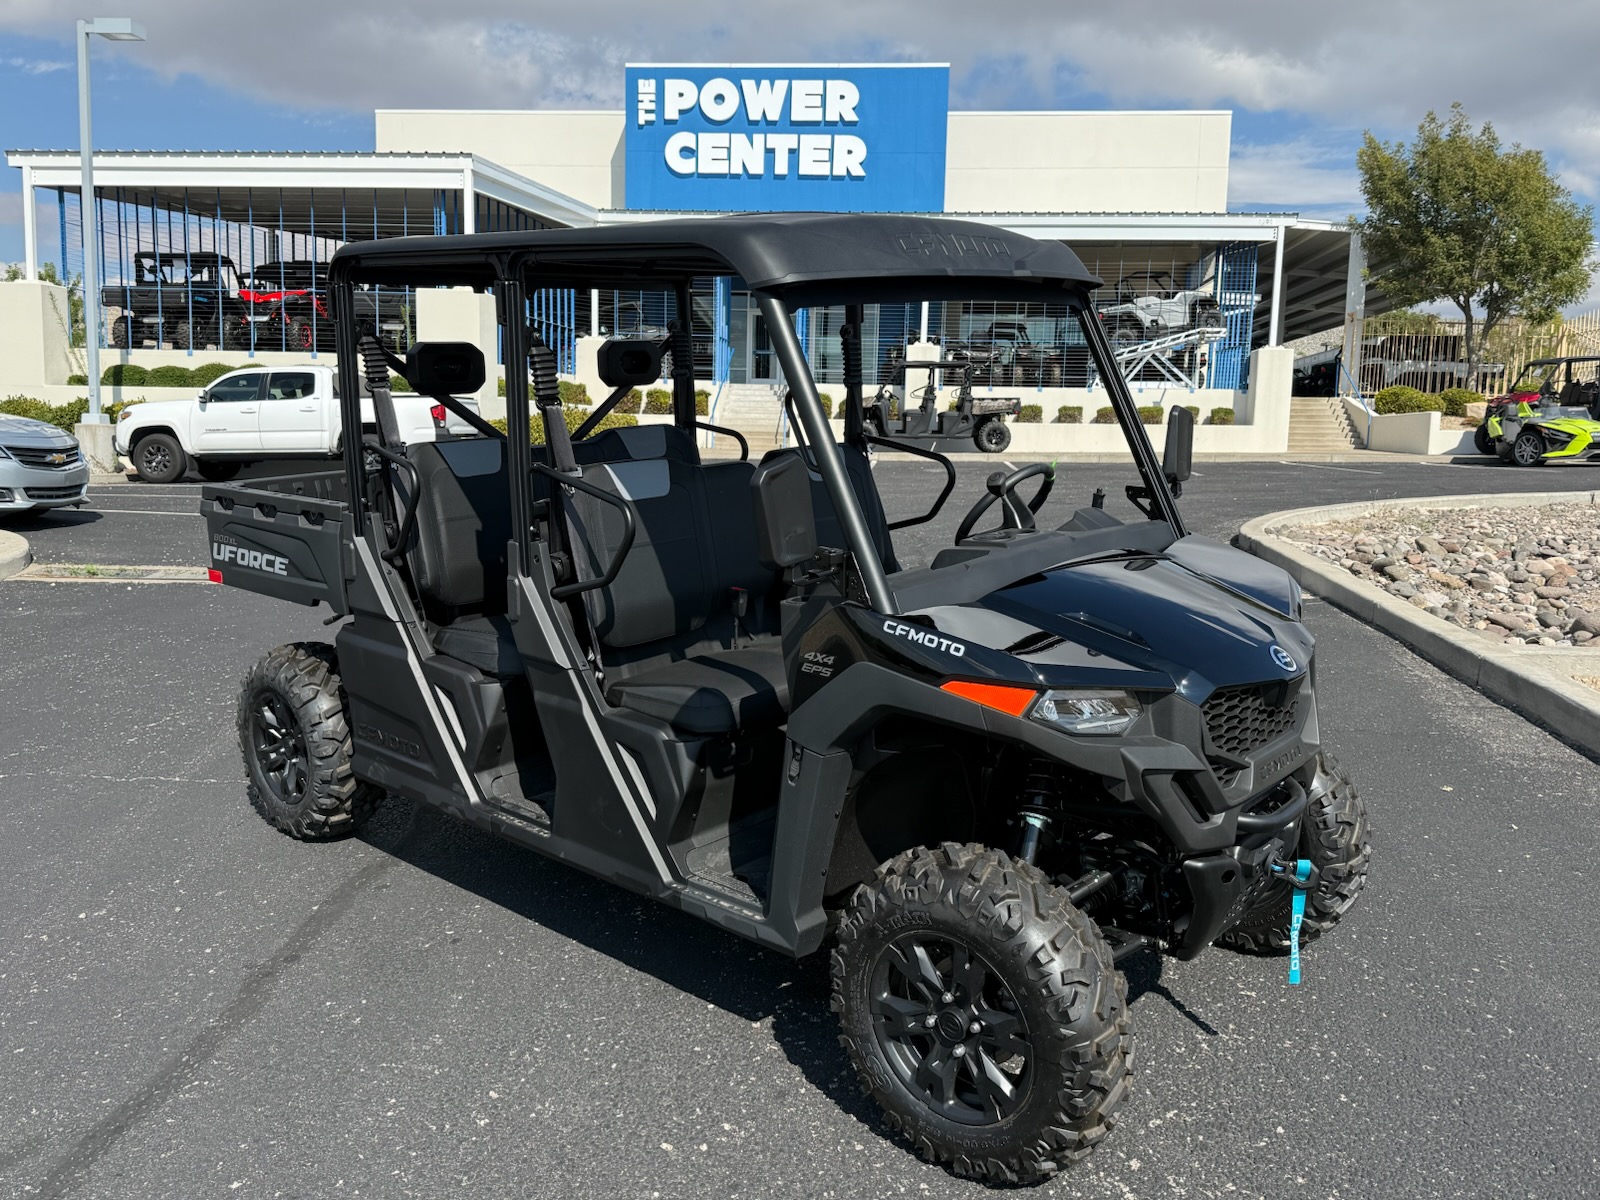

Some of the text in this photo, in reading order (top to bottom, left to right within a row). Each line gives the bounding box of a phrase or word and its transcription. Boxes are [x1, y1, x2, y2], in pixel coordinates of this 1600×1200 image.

[637, 79, 656, 125] THE
[664, 78, 860, 122] POWER
[664, 131, 867, 176] CENTER
[895, 232, 1011, 258] CFMOTO
[213, 543, 288, 576] UFORCE
[883, 620, 965, 657] CFMOTO
[801, 663, 833, 677] EPS
[804, 652, 835, 665] 4X4
[1290, 914, 1304, 971] CFMOTO
